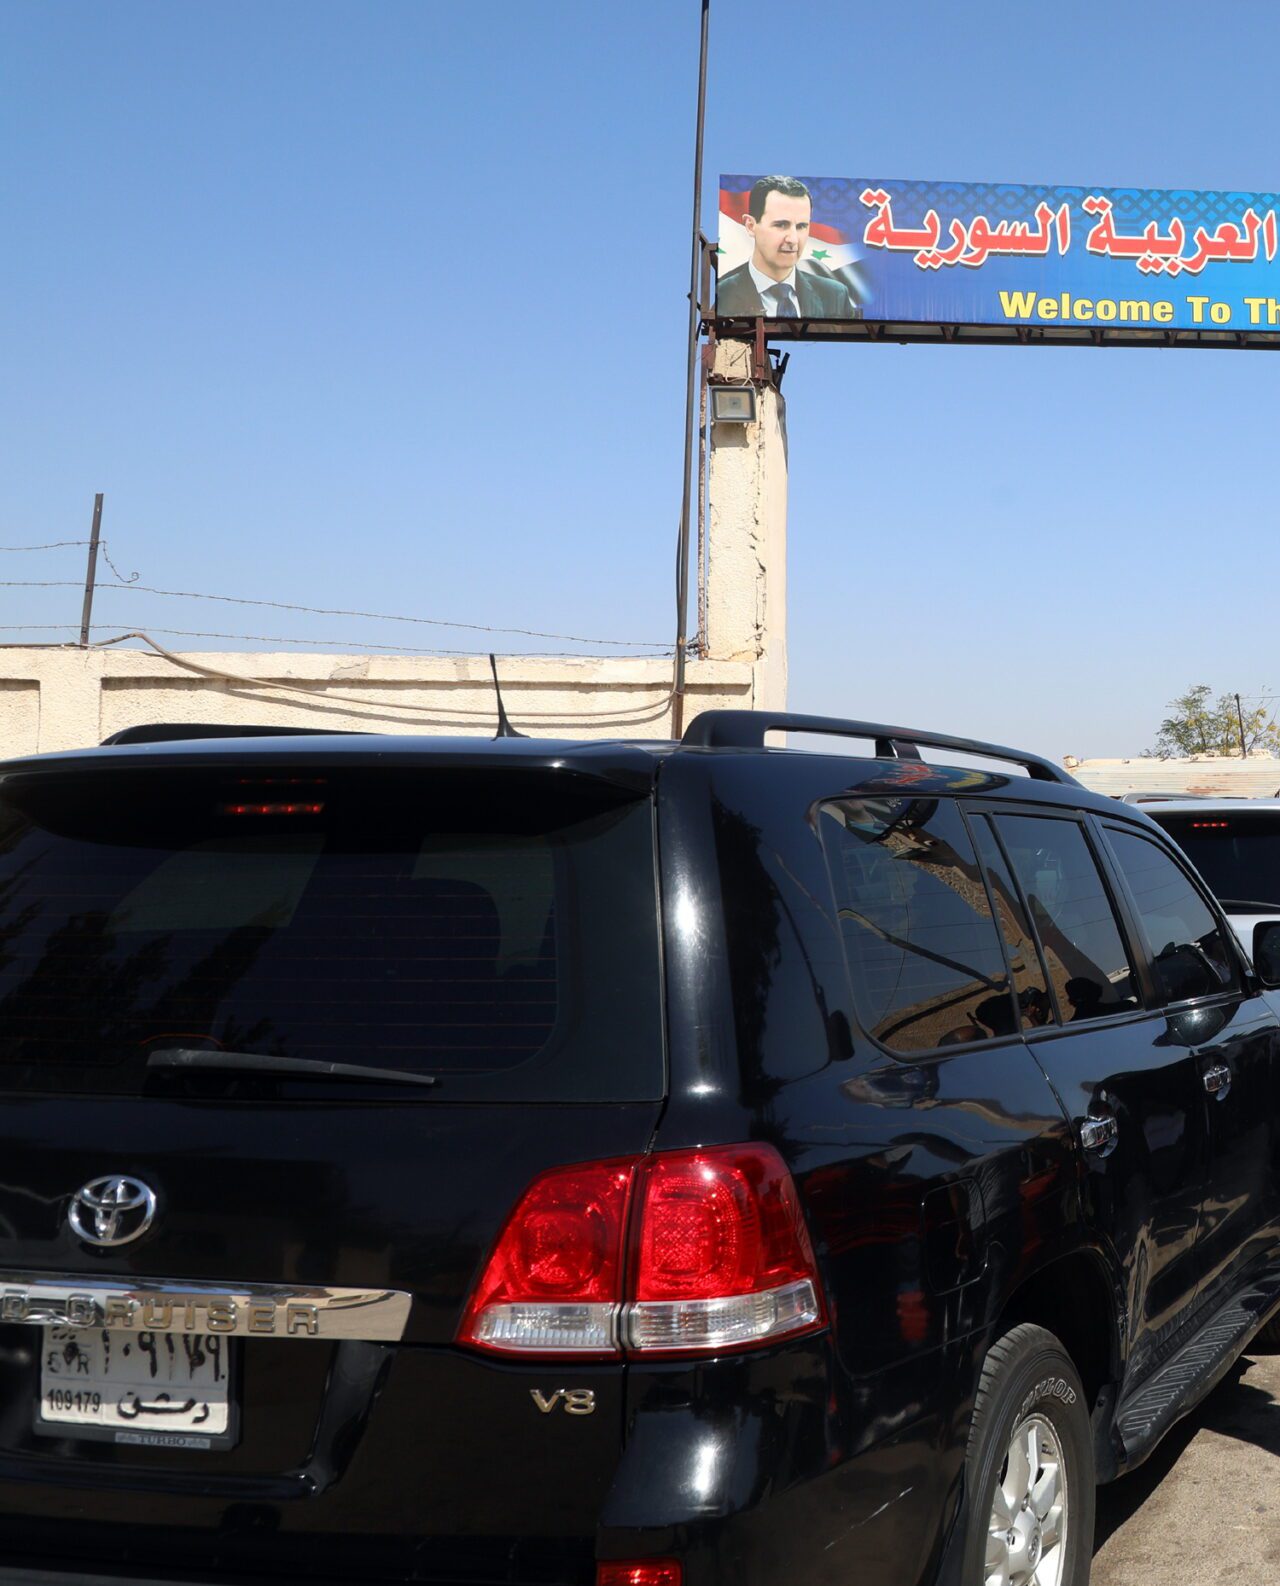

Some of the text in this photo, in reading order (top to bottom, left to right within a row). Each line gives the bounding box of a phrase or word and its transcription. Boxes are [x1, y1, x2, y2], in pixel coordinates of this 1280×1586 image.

[859, 188, 1071, 269] السورية
[1082, 195, 1278, 276] العربية
[999, 291, 1175, 322] Welcome
[1186, 296, 1232, 324] To
[65, 1291, 319, 1335] CRUISER
[47, 1388, 101, 1414] 109179
[530, 1388, 596, 1415] V8
[139, 1434, 187, 1446] TURBO
